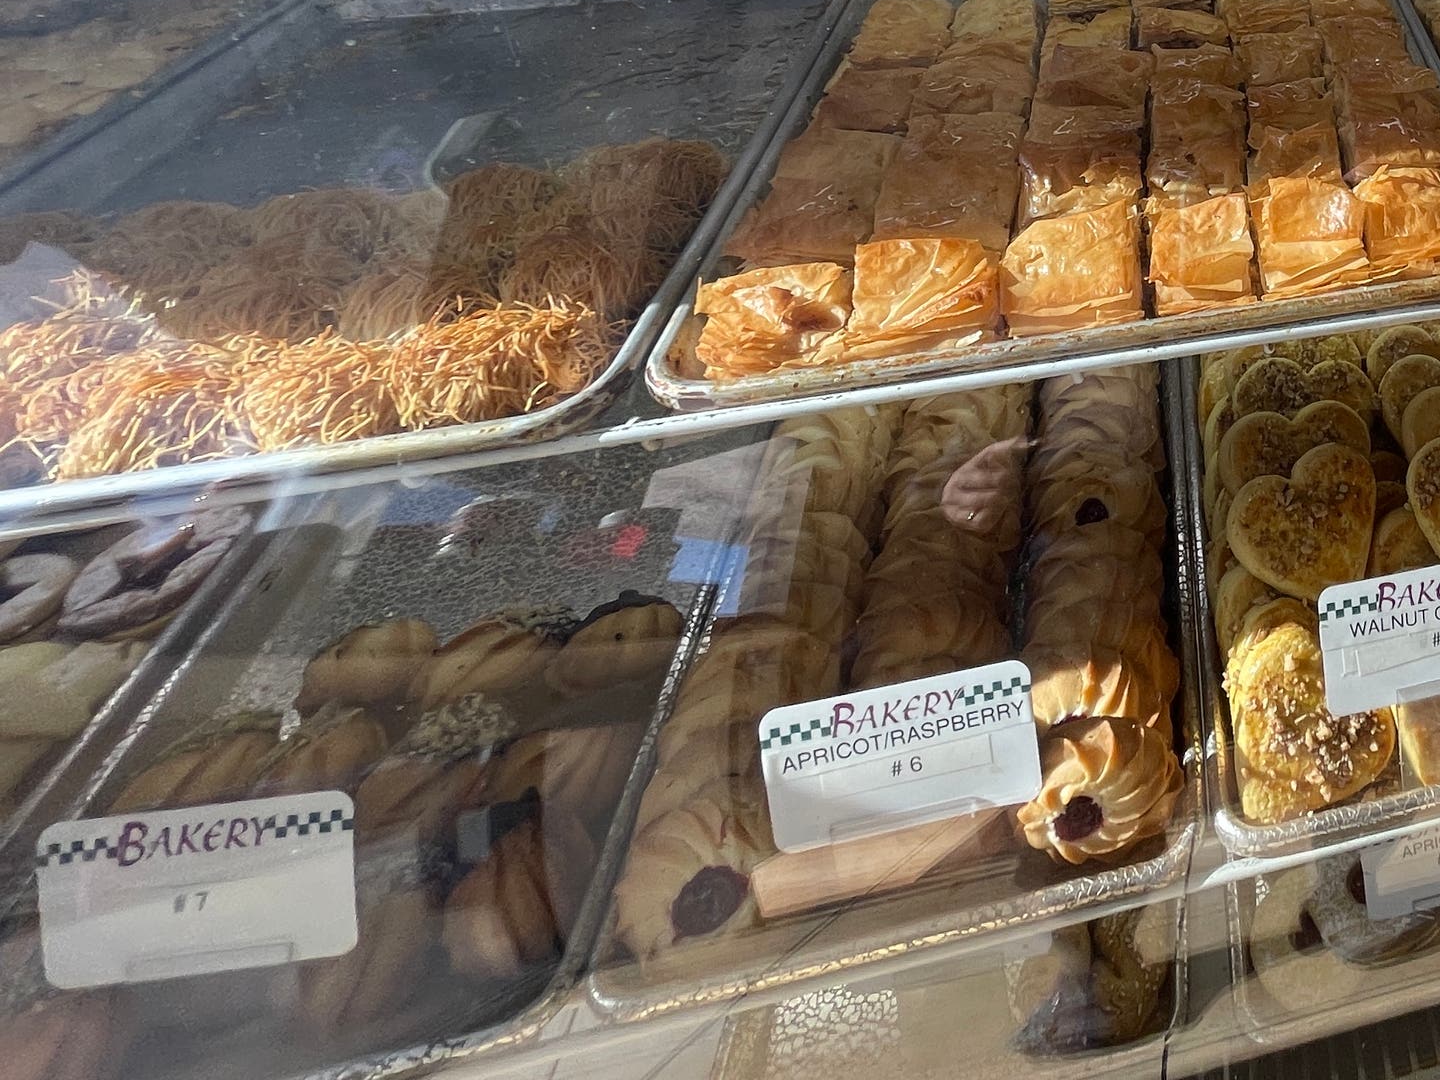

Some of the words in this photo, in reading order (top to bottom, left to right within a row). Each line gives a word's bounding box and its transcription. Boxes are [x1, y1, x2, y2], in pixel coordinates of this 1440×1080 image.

[1350, 608, 1428, 638] WALNUT
[782, 700, 1025, 775] APRICOT/RASPBERRY
[831, 685, 965, 739] BAKERY
[117, 815, 277, 867] BAKERY
